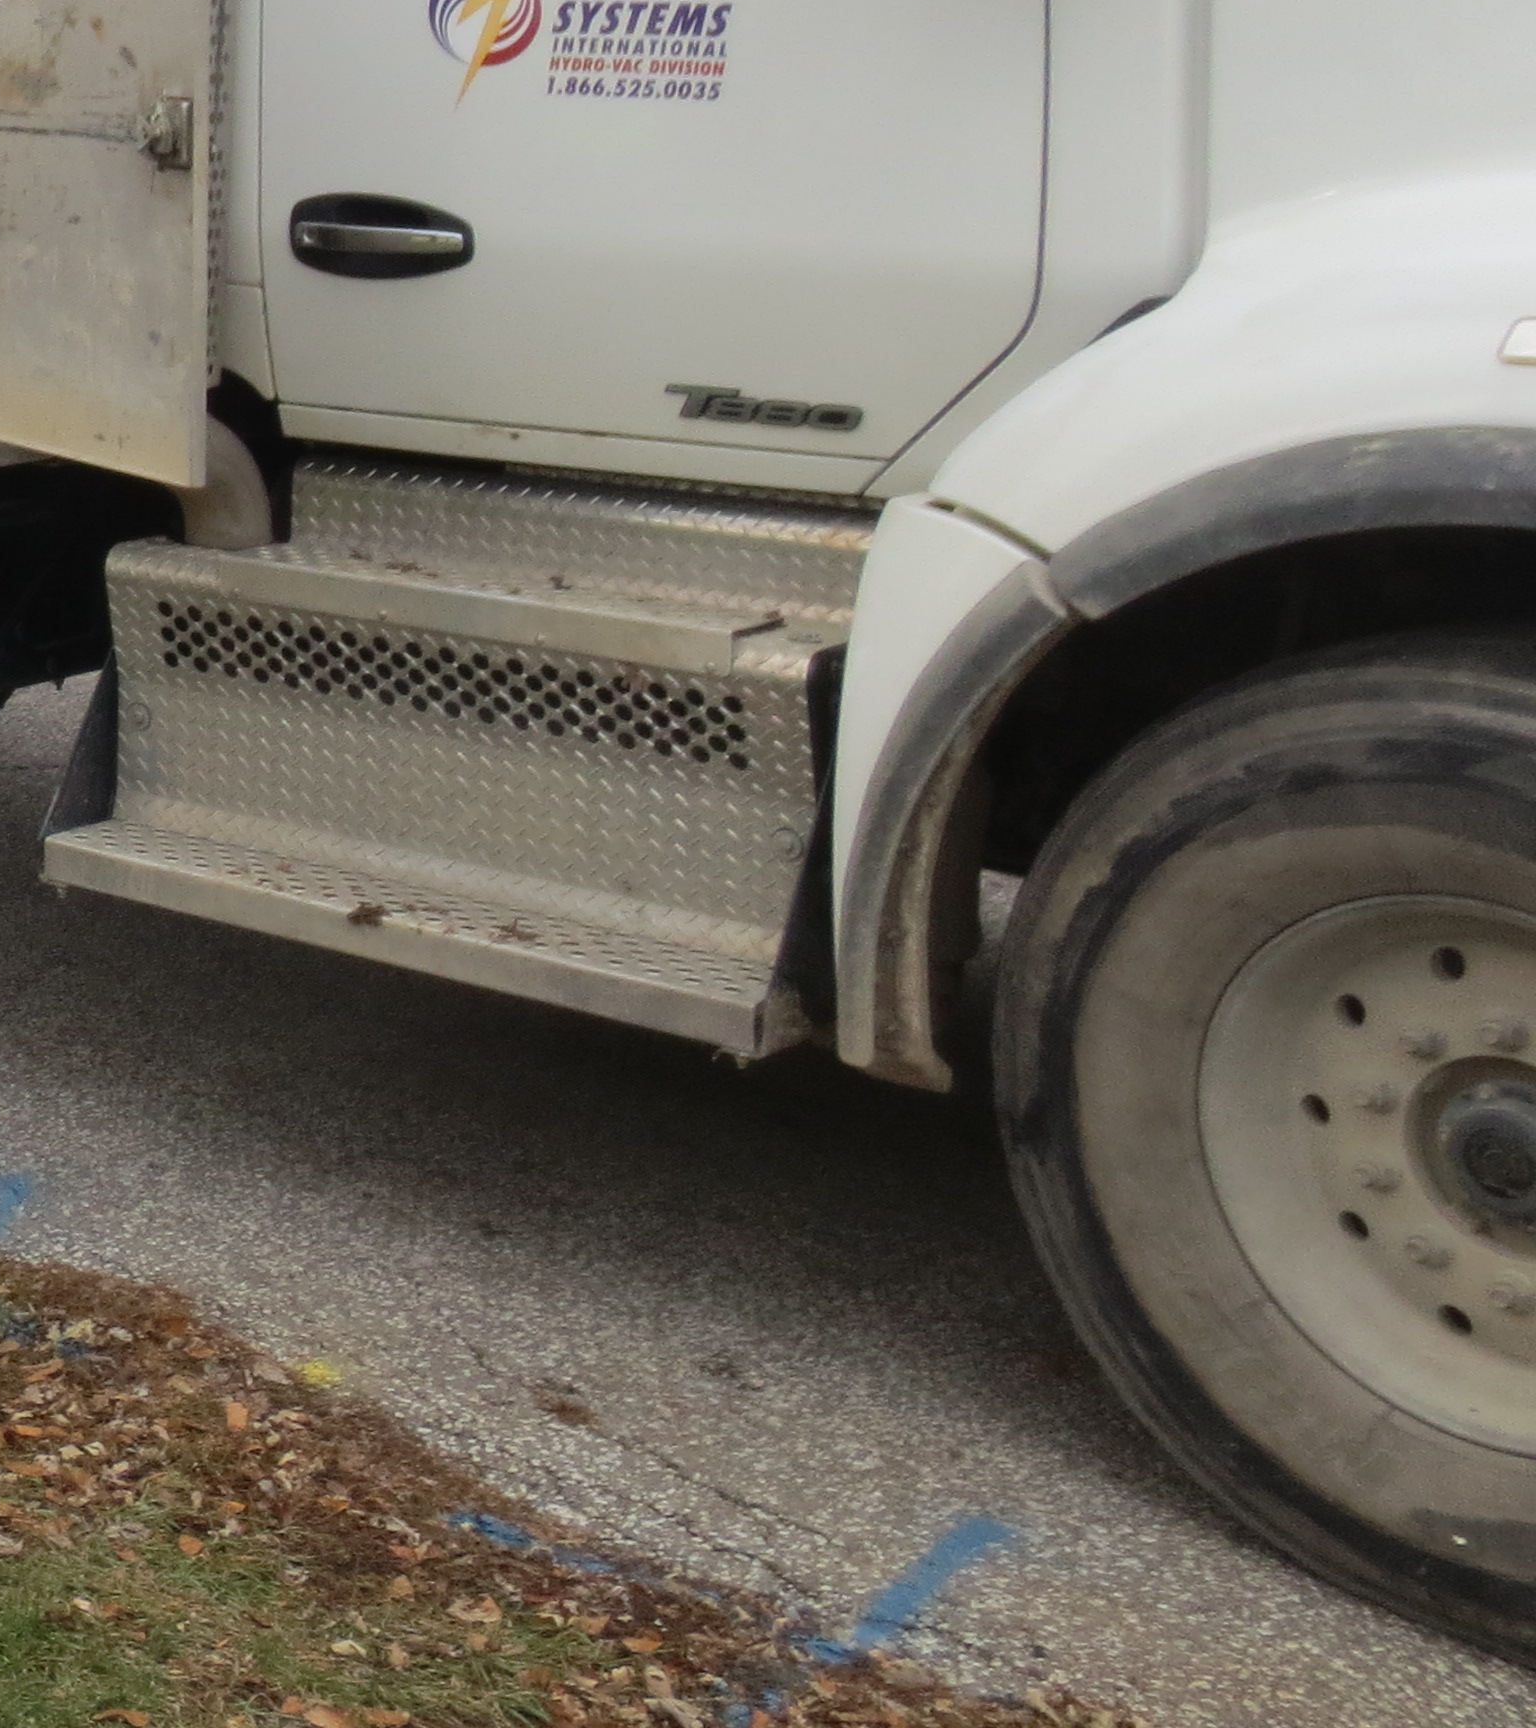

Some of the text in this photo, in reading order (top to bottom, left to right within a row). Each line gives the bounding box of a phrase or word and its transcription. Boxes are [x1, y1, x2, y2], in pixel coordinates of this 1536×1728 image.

[551, 0, 733, 37] SYSTEMS
[552, 37, 728, 58] INTERNATIONAL
[549, 56, 726, 76] HYDRO-VAC DIVISION
[546, 75, 723, 101] 1.866.525.0035
[664, 383, 865, 433] T880
